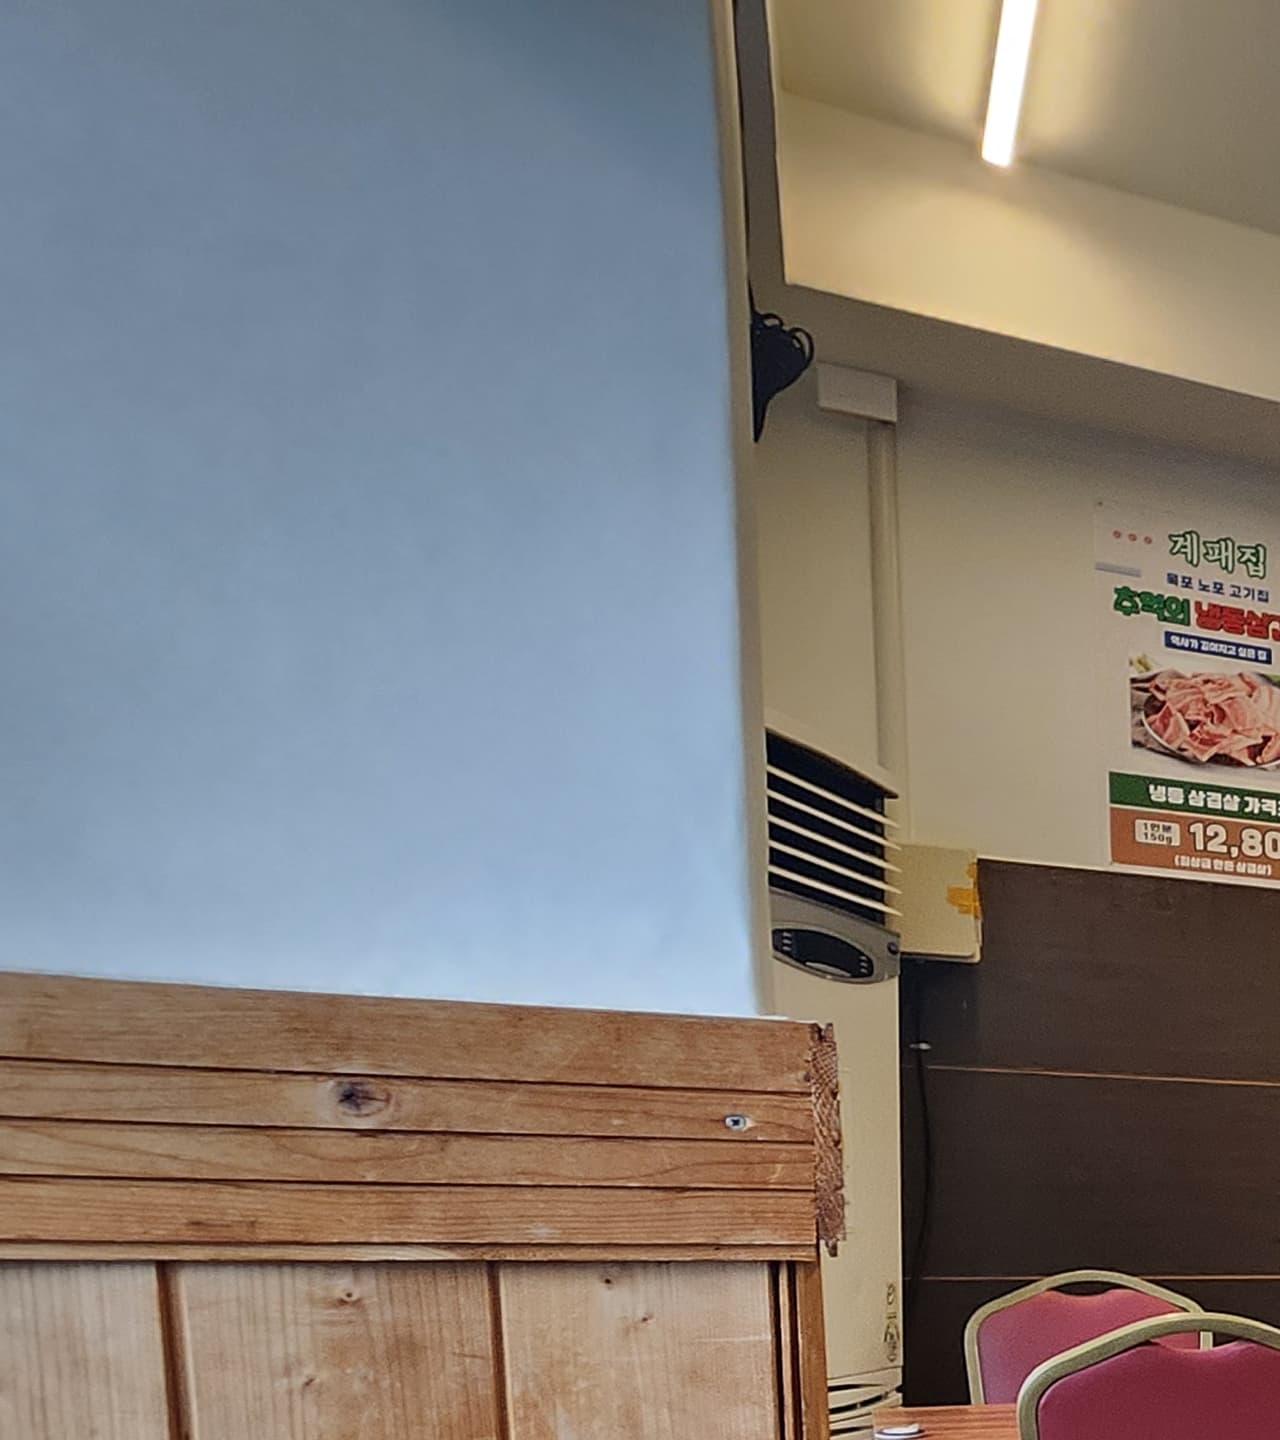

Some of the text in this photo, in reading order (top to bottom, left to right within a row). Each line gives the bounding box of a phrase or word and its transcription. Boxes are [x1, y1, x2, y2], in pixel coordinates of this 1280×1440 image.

[1168, 530, 1268, 579] 계패집
[1166, 572, 1270, 603] 목포 노포 고기집
[1113, 586, 1191, 627] 추억의
[1149, 784, 1184, 804] 냉동
[1187, 789, 1241, 812] 삼겹살
[1143, 832, 1172, 845] 150g
